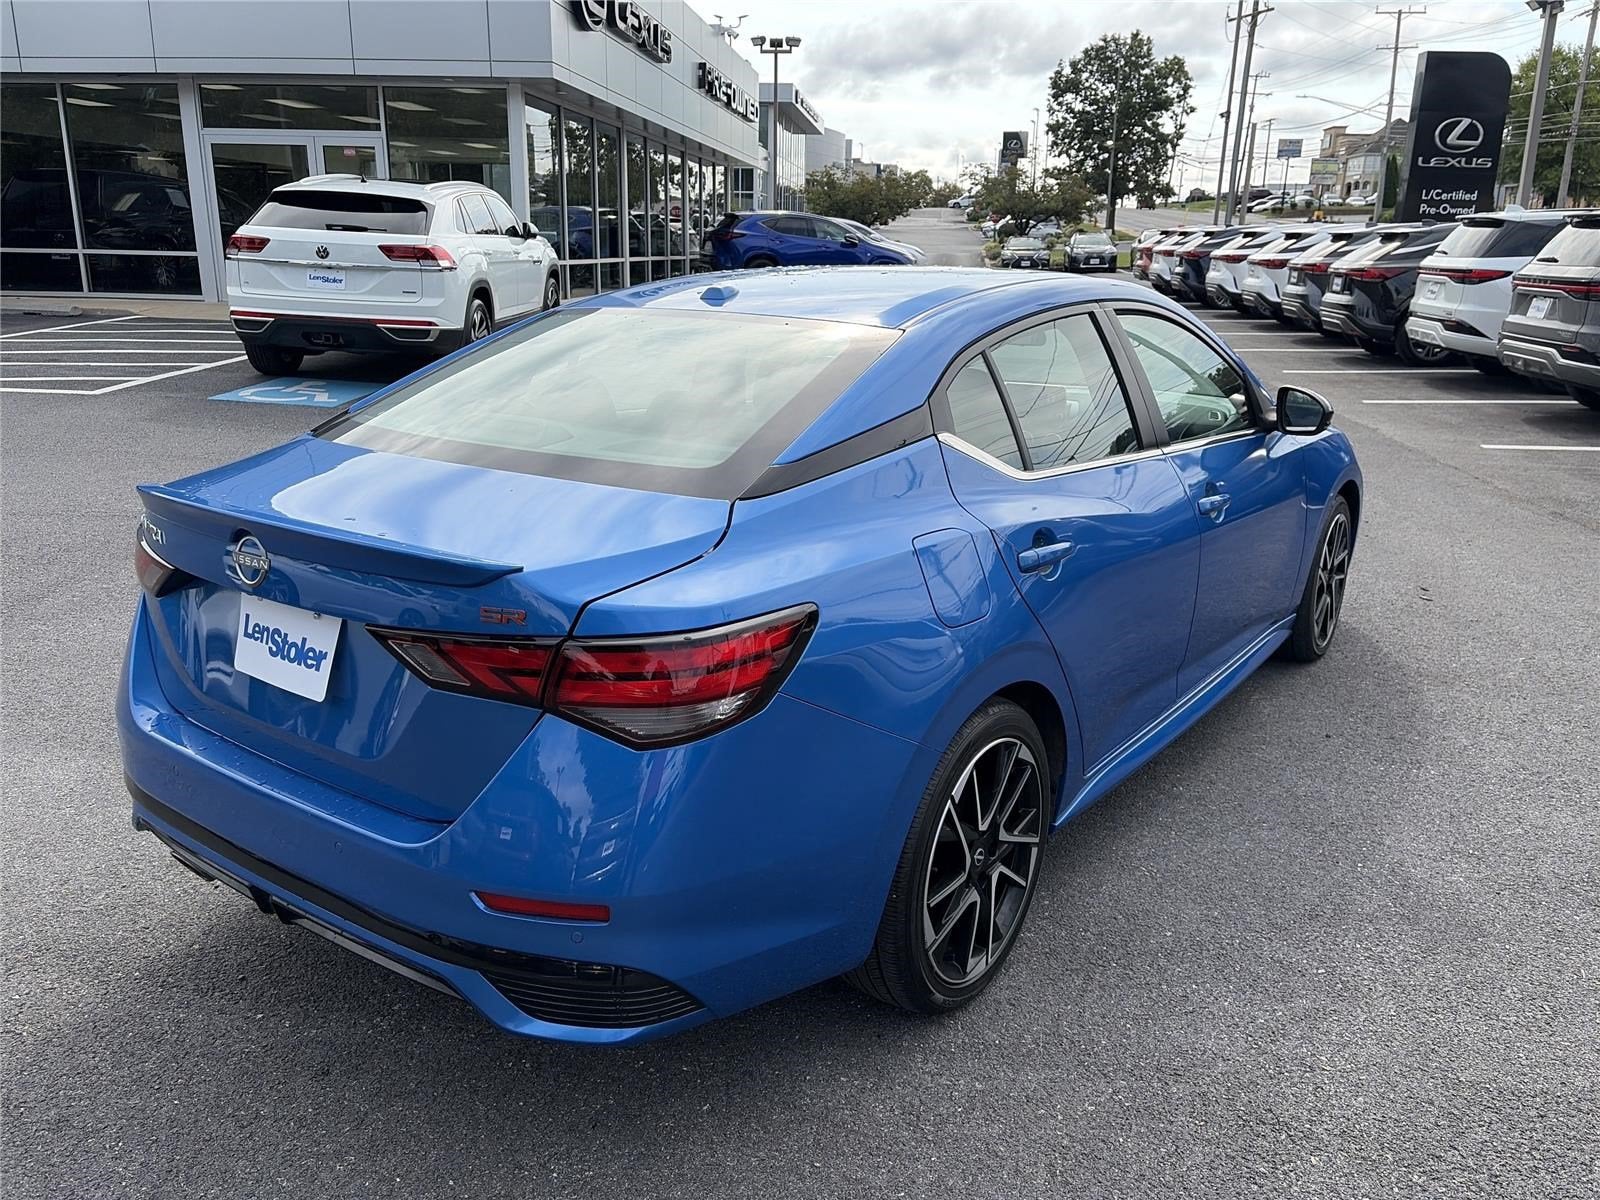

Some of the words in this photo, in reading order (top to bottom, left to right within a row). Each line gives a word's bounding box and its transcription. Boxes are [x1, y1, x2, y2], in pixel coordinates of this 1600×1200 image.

[614, 0, 673, 64] LEXUS
[1417, 156, 1493, 168] LEXUS
[1421, 189, 1478, 201] L/Certified
[1419, 203, 1476, 215] Pre-Owned
[234, 553, 269, 571] NISSAN
[479, 606, 527, 626] SR
